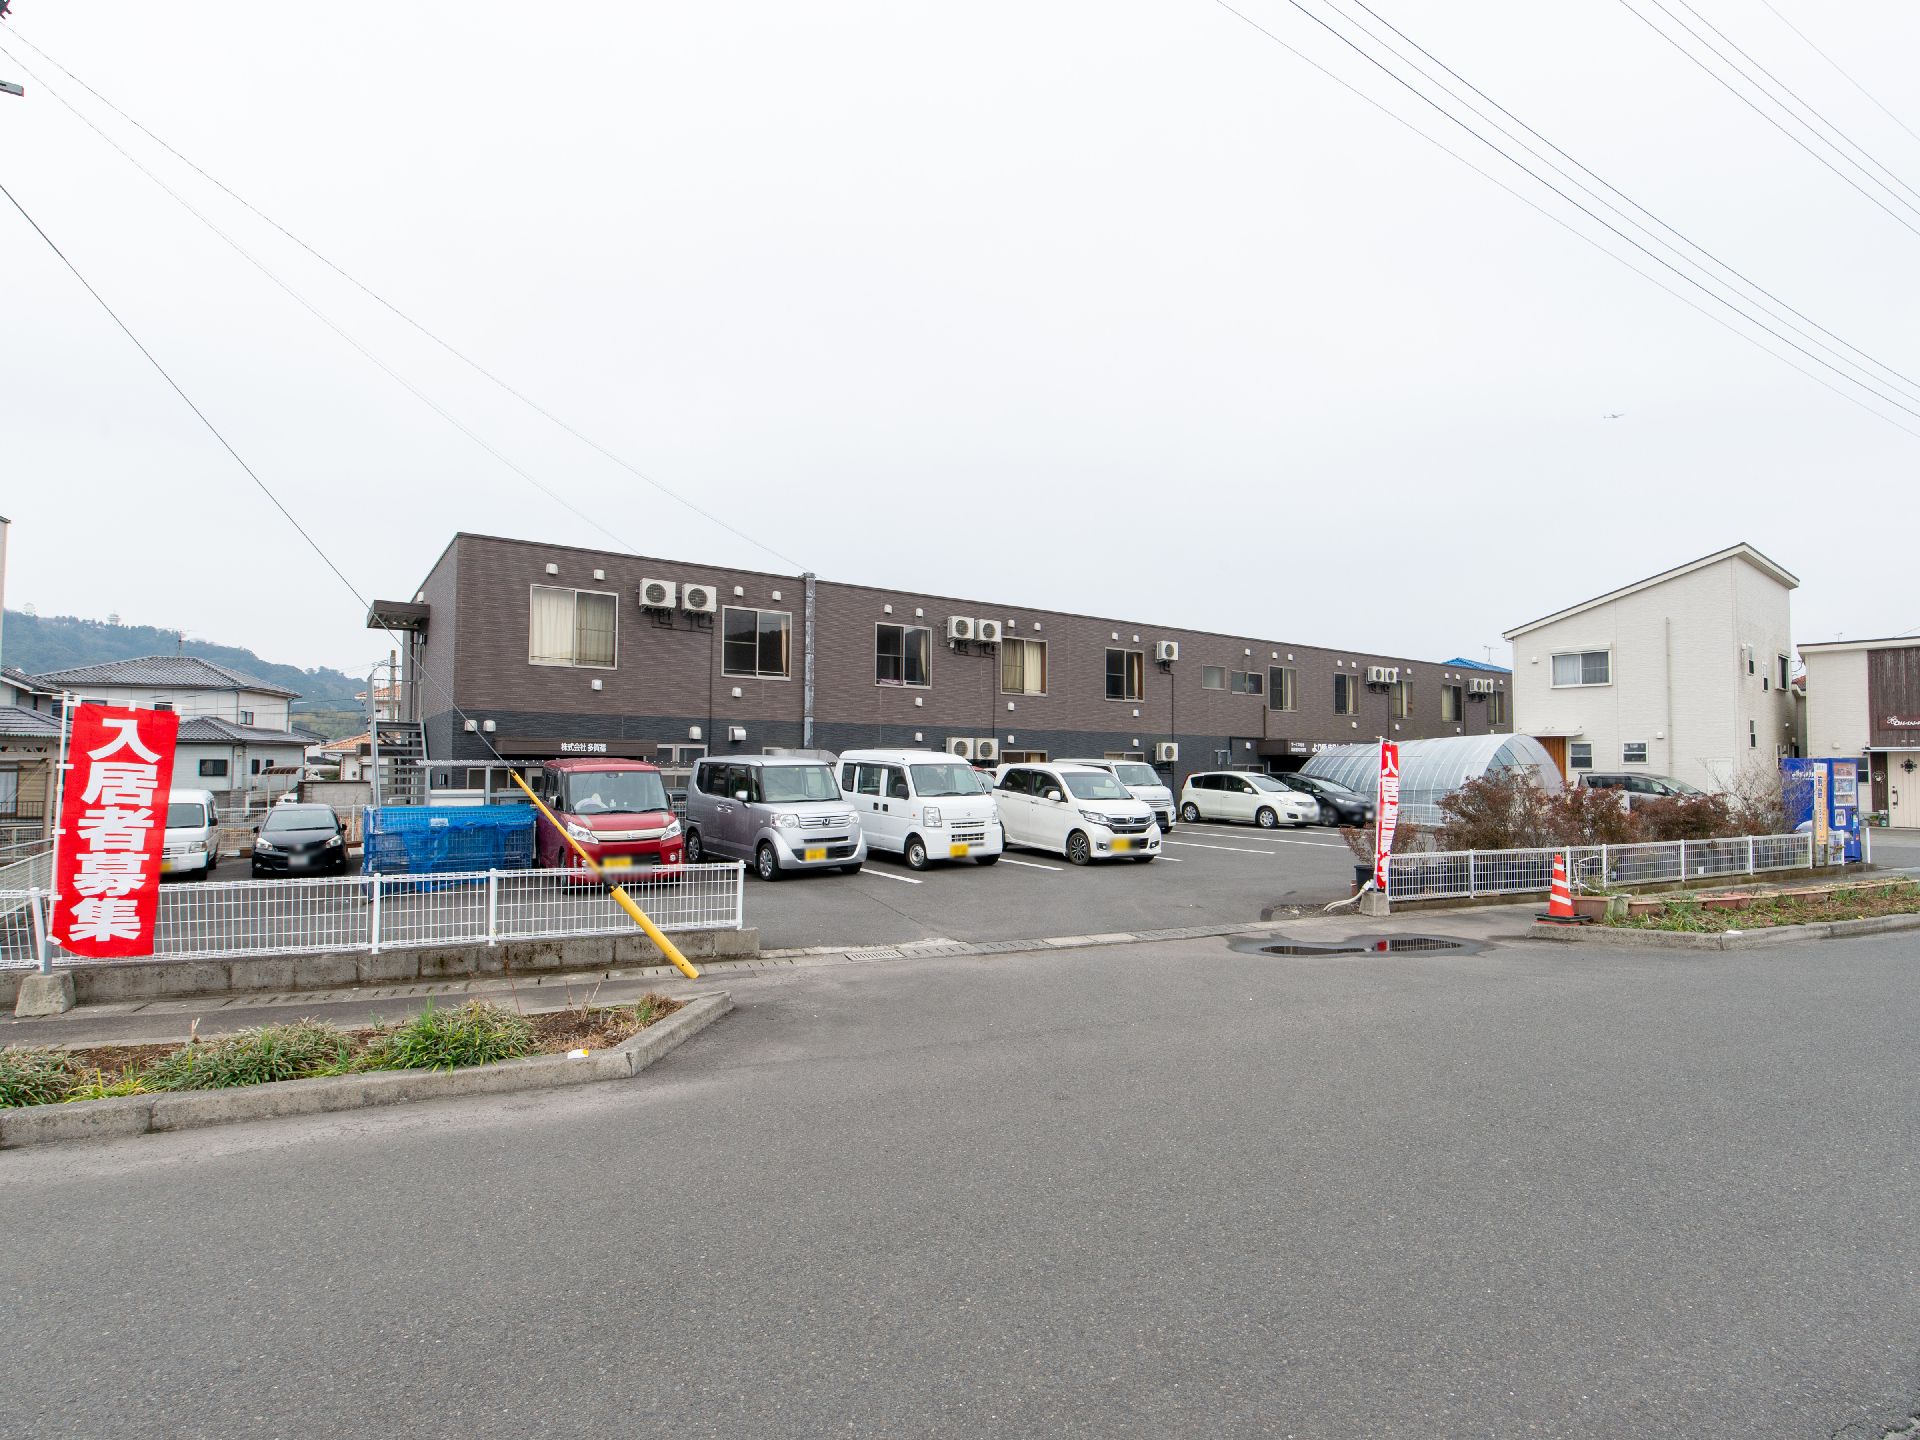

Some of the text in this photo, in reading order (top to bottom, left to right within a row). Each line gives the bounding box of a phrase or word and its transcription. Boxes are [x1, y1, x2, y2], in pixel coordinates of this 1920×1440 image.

[560, 742, 587, 752] 株式会社
[68, 718, 162, 942] 入居者募集
